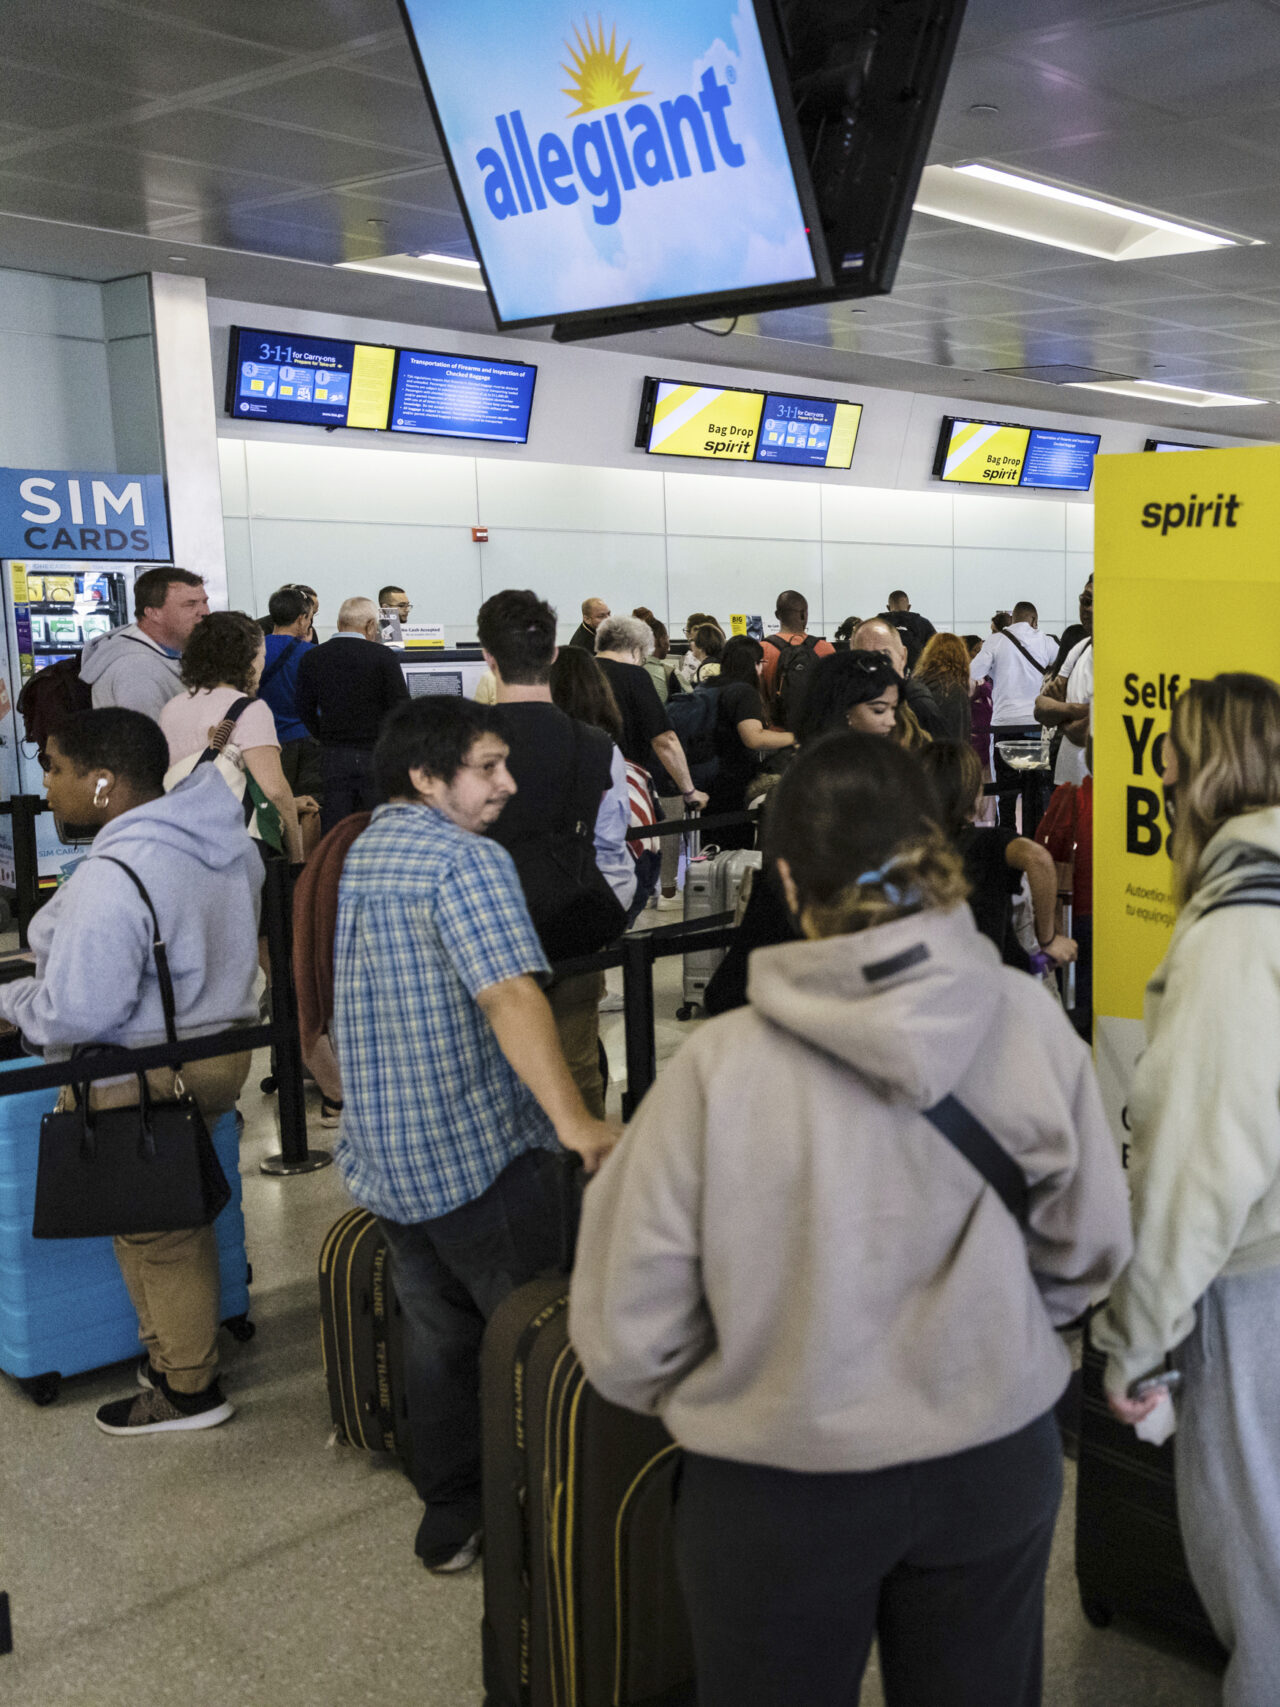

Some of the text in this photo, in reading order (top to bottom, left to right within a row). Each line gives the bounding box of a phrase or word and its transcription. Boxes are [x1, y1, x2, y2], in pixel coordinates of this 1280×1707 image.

[476, 65, 745, 225] allegiant
[259, 343, 336, 363] 3-1-1 for Carry-ons
[410, 357, 451, 369] Transportation
[458, 363, 481, 372] Firearms
[493, 367, 519, 377] Inspection
[446, 370, 468, 378] Checked
[776, 404, 798, 418] 3-1-1
[708, 423, 754, 438] Bag Drop
[704, 440, 751, 454] spirit
[987, 454, 1021, 466] Bag Drop
[983, 468, 1017, 480] spirit
[20, 477, 145, 526] SIM
[1141, 493, 1241, 536] spirit
[24, 526, 149, 551] CARDS
[1124, 672, 1180, 711] Self
[55, 847, 85, 856] CARDS
